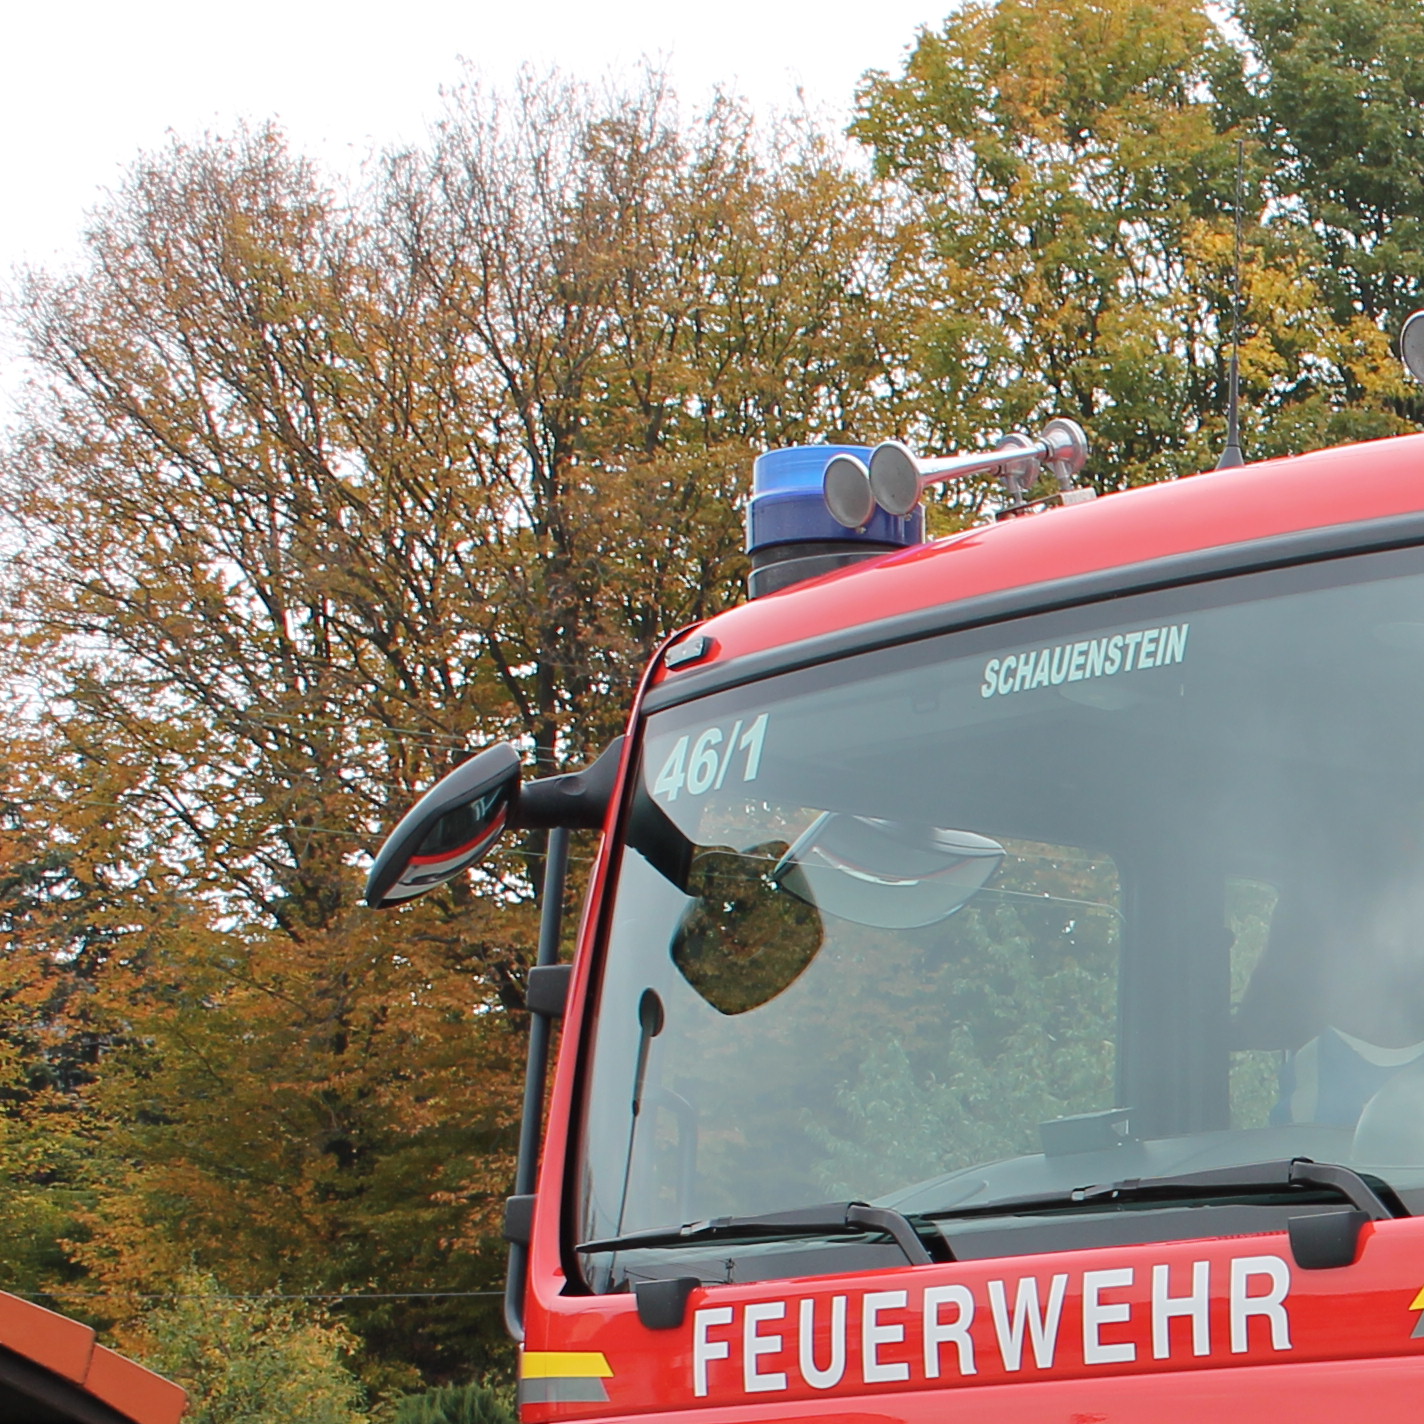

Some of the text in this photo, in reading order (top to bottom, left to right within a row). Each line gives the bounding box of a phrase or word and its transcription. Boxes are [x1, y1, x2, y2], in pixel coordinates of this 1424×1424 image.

[981, 622, 1189, 699] SCHAUENSTEIN
[652, 712, 770, 802] 46/1
[691, 1254, 1294, 1398] FEUERWEHR
